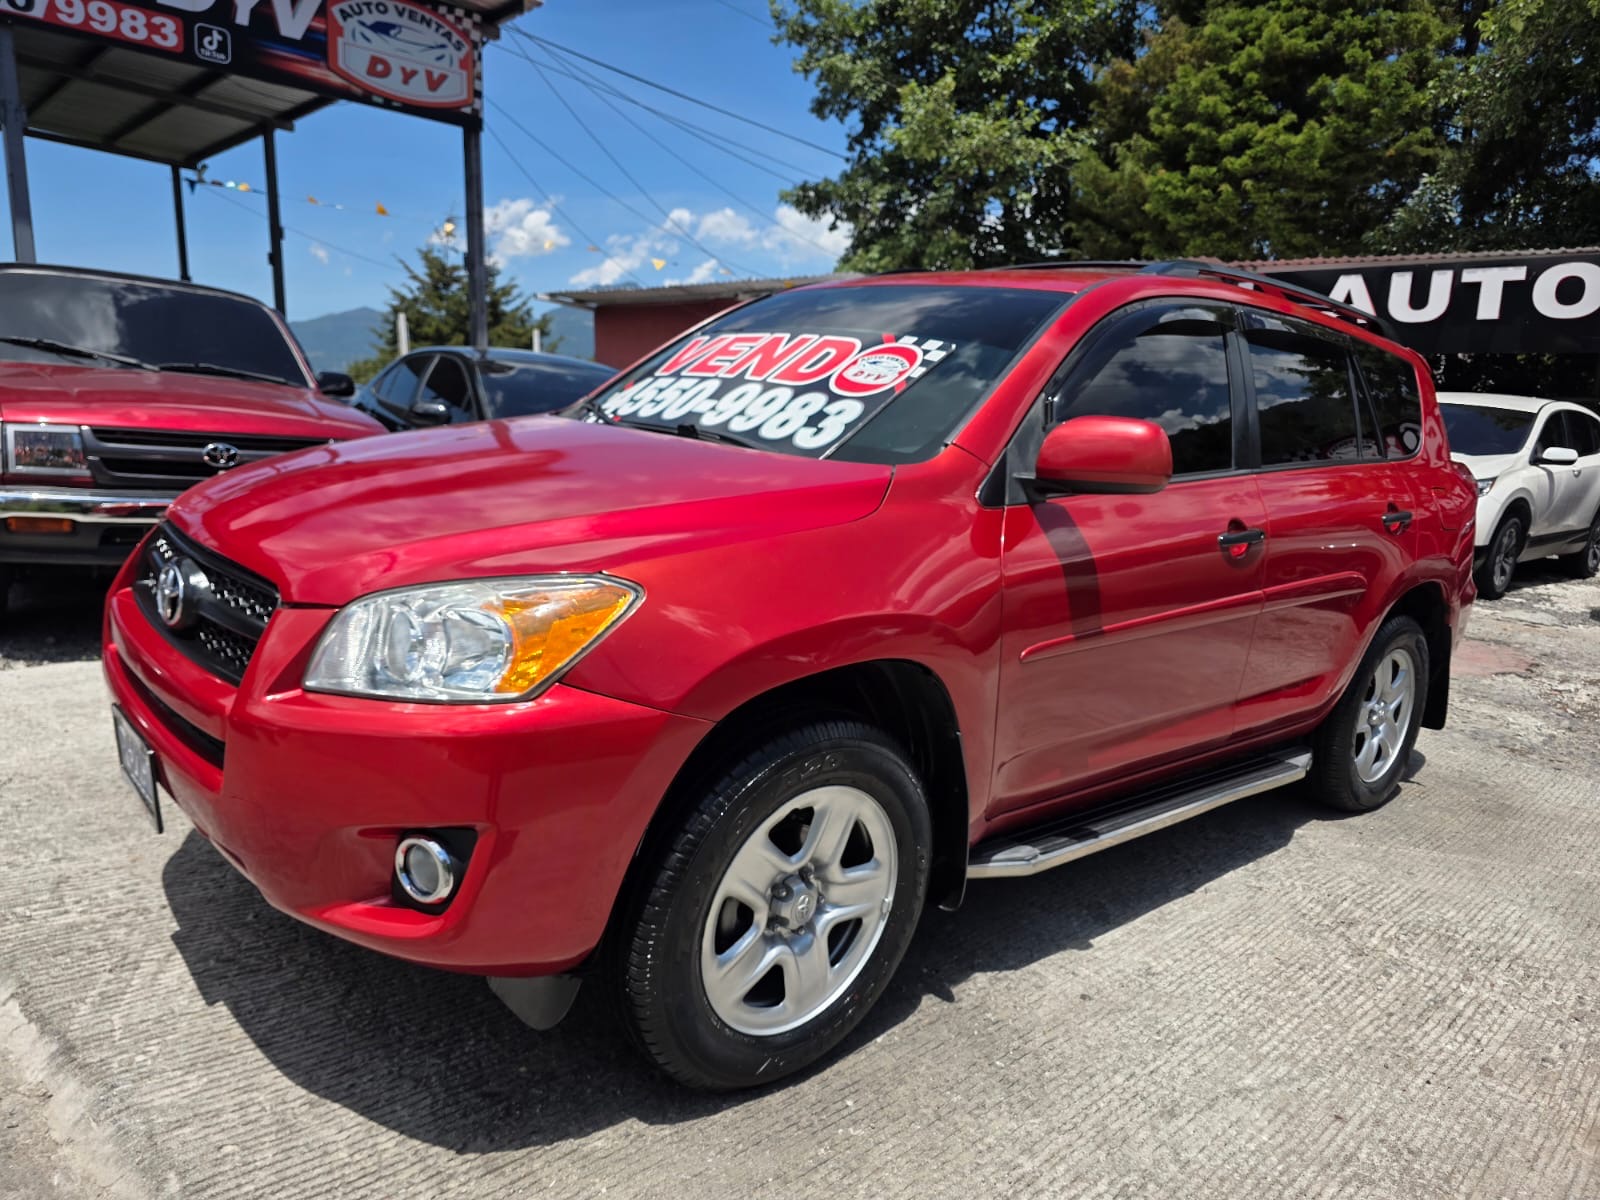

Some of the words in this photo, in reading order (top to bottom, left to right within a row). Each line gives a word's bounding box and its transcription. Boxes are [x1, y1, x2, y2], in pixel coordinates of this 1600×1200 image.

[338, 1, 389, 22] AUTO
[394, 4, 466, 51] VENTAS
[366, 55, 449, 92] DYV
[1322, 261, 1600, 323] AUTO
[601, 376, 865, 449] 4550-9983
